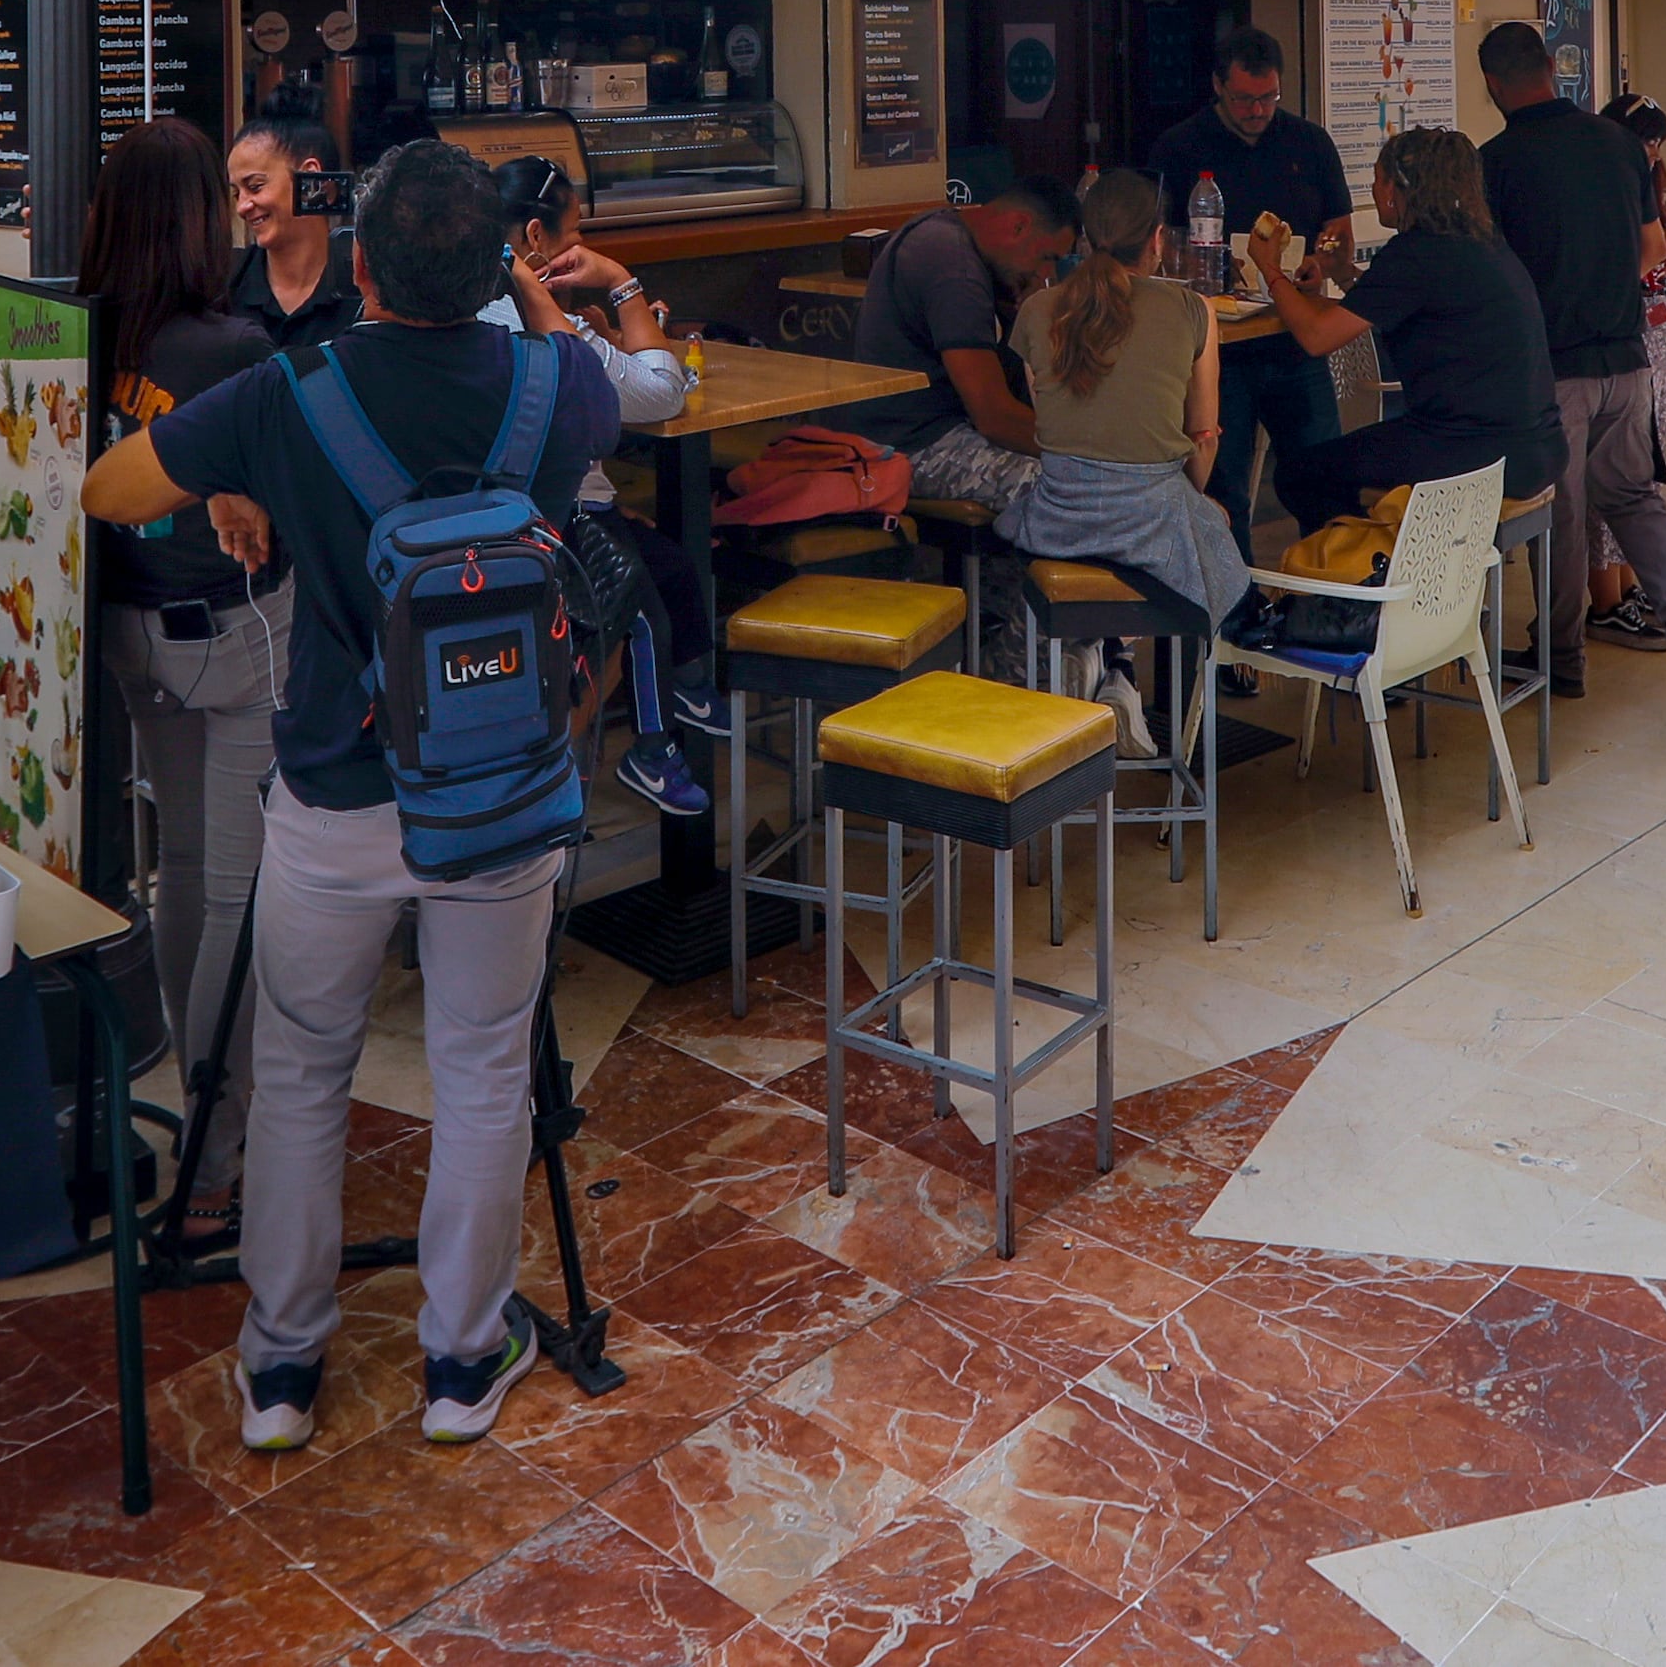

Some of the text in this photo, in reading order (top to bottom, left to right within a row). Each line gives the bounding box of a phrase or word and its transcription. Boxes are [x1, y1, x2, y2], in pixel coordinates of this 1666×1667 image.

[99, 16, 135, 26] Gambas
[154, 15, 188, 27] plancha
[99, 38, 133, 49] Gambas
[154, 59, 188, 70] cocidos
[100, 107, 145, 118] Concha fin
